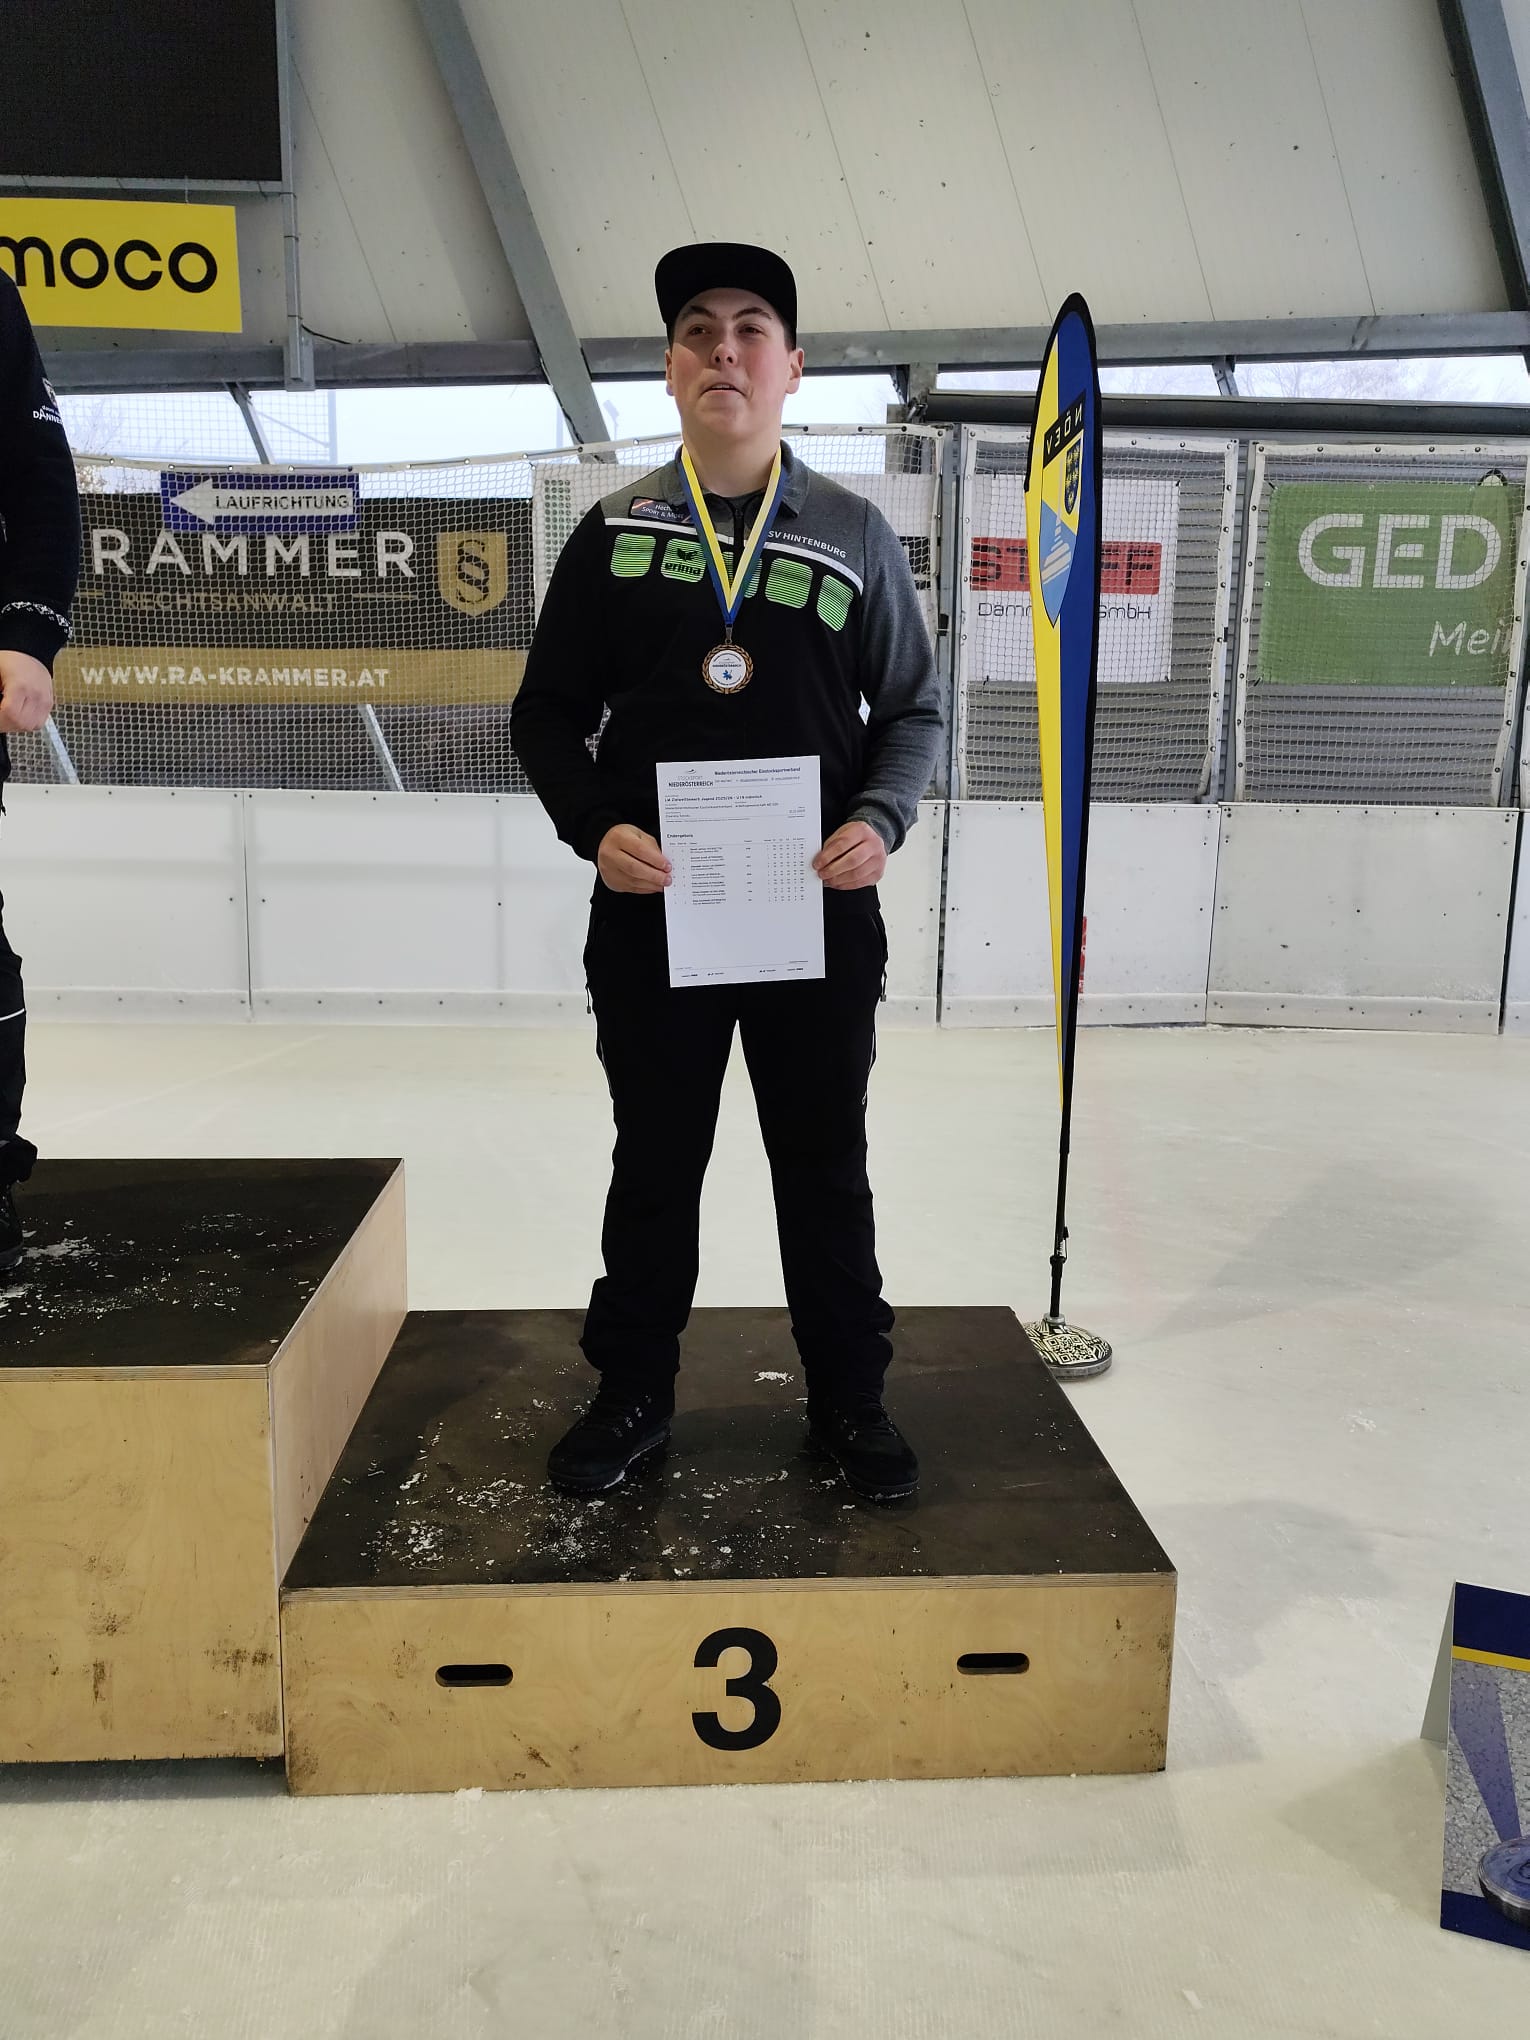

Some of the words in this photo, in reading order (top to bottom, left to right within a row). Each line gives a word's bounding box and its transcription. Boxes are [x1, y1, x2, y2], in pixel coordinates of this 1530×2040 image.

[215, 493, 350, 511] LAUFRICHTUNG
[768, 530, 781, 539] SV
[782, 532, 847, 559] HINTENBURG
[1298, 513, 1501, 590] GED
[664, 562, 701, 575] erima
[120, 592, 337, 612] RECHTSANWALT
[80, 666, 390, 688] WWW.RA-KRAMMER.AT
[691, 1627, 783, 1752] 3
